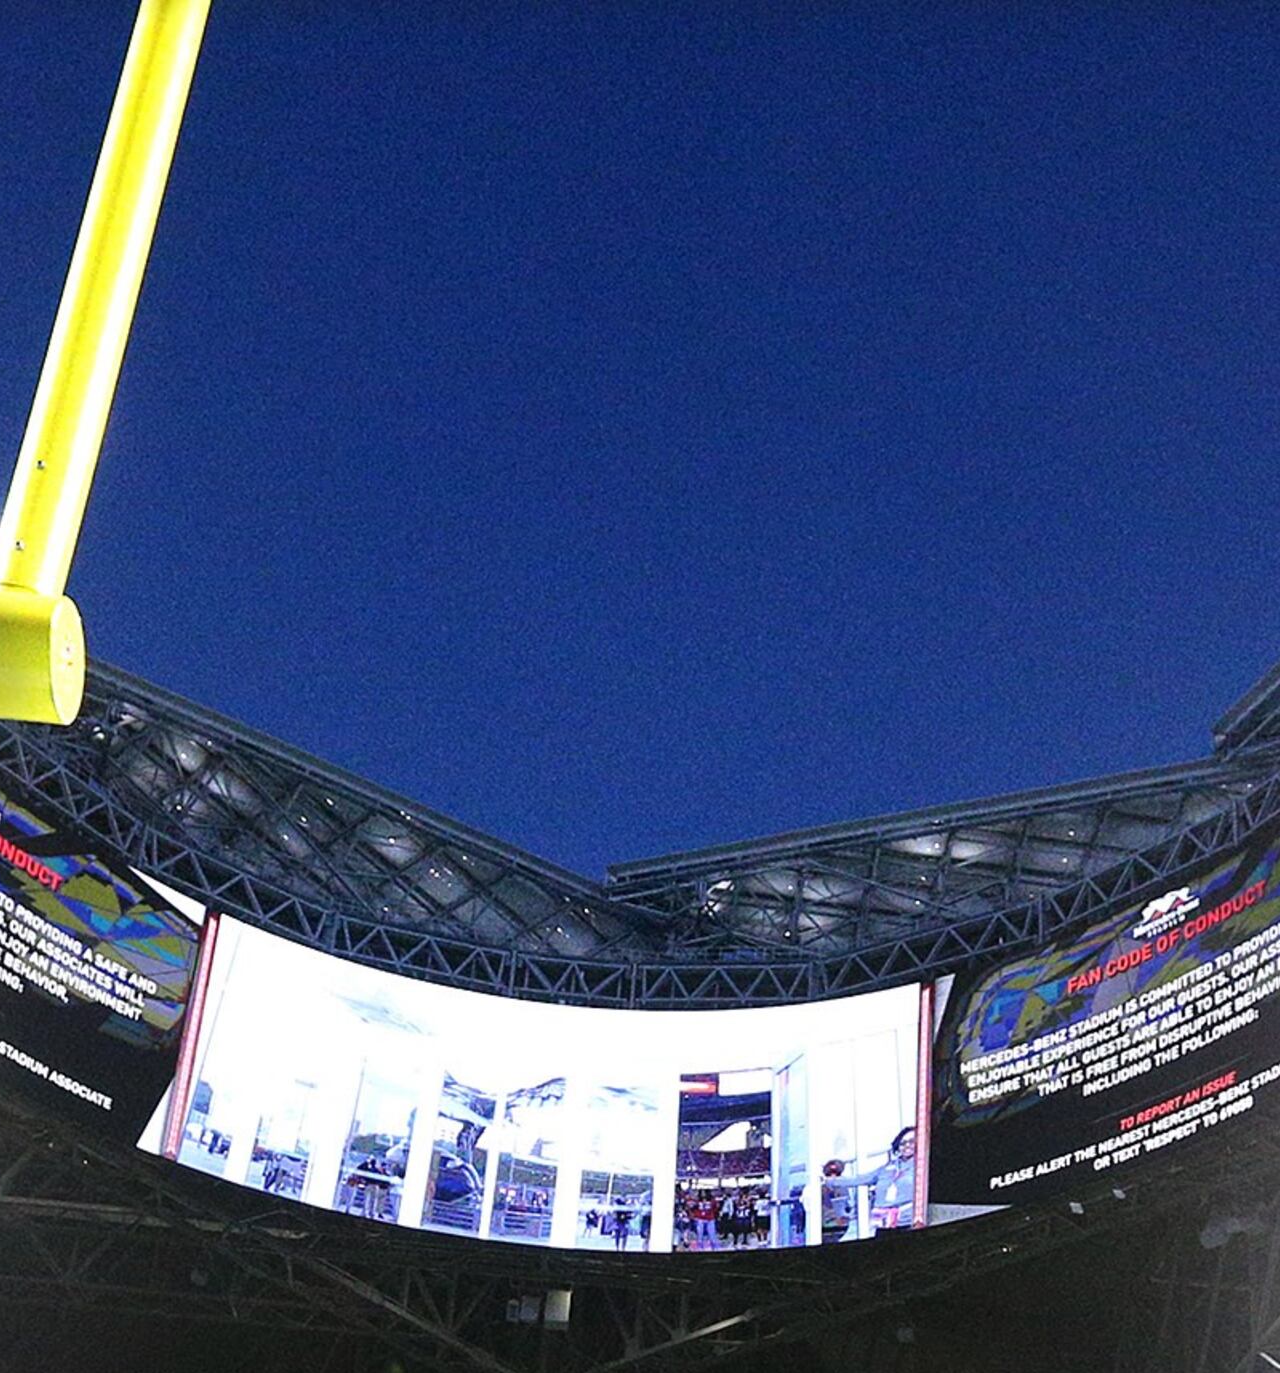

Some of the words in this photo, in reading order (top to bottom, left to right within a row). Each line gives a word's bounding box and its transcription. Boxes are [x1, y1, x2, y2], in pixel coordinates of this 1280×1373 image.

[0, 892, 15, 912] TO
[16, 904, 82, 955] PROVIDING
[83, 948, 93, 962] A
[95, 952, 128, 980] SAFE
[128, 976, 157, 995] AND
[10, 920, 37, 948] OUR
[37, 939, 112, 990] ASSOCIATES
[115, 982, 145, 1008] WILL
[1067, 967, 1102, 993] FAN
[1105, 944, 1154, 977] CODE
[1156, 930, 1181, 954] OF
[1184, 881, 1267, 939] CONDUCT
[30, 952, 49, 971] AN
[50, 964, 142, 1021] ENVIRONMENT
[960, 1031, 1067, 1075] MERCEDES-BENZ
[1069, 1005, 1123, 1037] STADIUM
[1125, 998, 1137, 1012] IS
[1140, 962, 1213, 1003] COMMITTED
[1215, 953, 1231, 967] TO
[967, 1053, 1040, 1087] ENJOYABLE
[1042, 1025, 1119, 1062] EXPERIENCE
[1121, 1012, 1146, 1032] FOR
[1148, 1001, 1174, 1021] OUR
[1231, 954, 1258, 978] OUR
[968, 1078, 1020, 1104] ENSURE
[1023, 1066, 1054, 1086] THAT
[1054, 1058, 1081, 1077] ALL
[1083, 1037, 1131, 1062] GUESTS
[1131, 1023, 1158, 1042] ARE
[1159, 1008, 1194, 1034] ABLE
[1196, 997, 1212, 1012] TO
[1214, 974, 1255, 1004] ENJOY
[1256, 962, 1275, 982] AN
[0, 1041, 49, 1079] STADIUM
[49, 1071, 113, 1110] ASSOCIATE
[1038, 1076, 1070, 1097] THAT
[1071, 1069, 1084, 1085] IS
[1086, 1058, 1119, 1078] FREE
[1121, 1039, 1158, 1066] FROM
[1159, 1002, 1233, 1047] DISRUPTIVE
[1082, 1062, 1152, 1096] INCLUDING
[1154, 1045, 1180, 1067] THE
[1181, 1009, 1259, 1055] FOLLOWING:
[990, 1167, 1034, 1189] PLEASE
[1035, 1154, 1072, 1175] ALERT
[1074, 1145, 1097, 1162] THE
[1099, 1126, 1151, 1154] NEAREST
[1153, 1081, 1250, 1133] MERCEDES-BENZ
[1093, 1155, 1111, 1170] OR
[1113, 1144, 1142, 1164] TEXT
[1203, 1112, 1218, 1128] TO
[1120, 1116, 1133, 1129] TO
[1136, 1096, 1182, 1124] REPORT
[1183, 1089, 1200, 1105] AN
[1202, 1070, 1238, 1096] ISSUE
